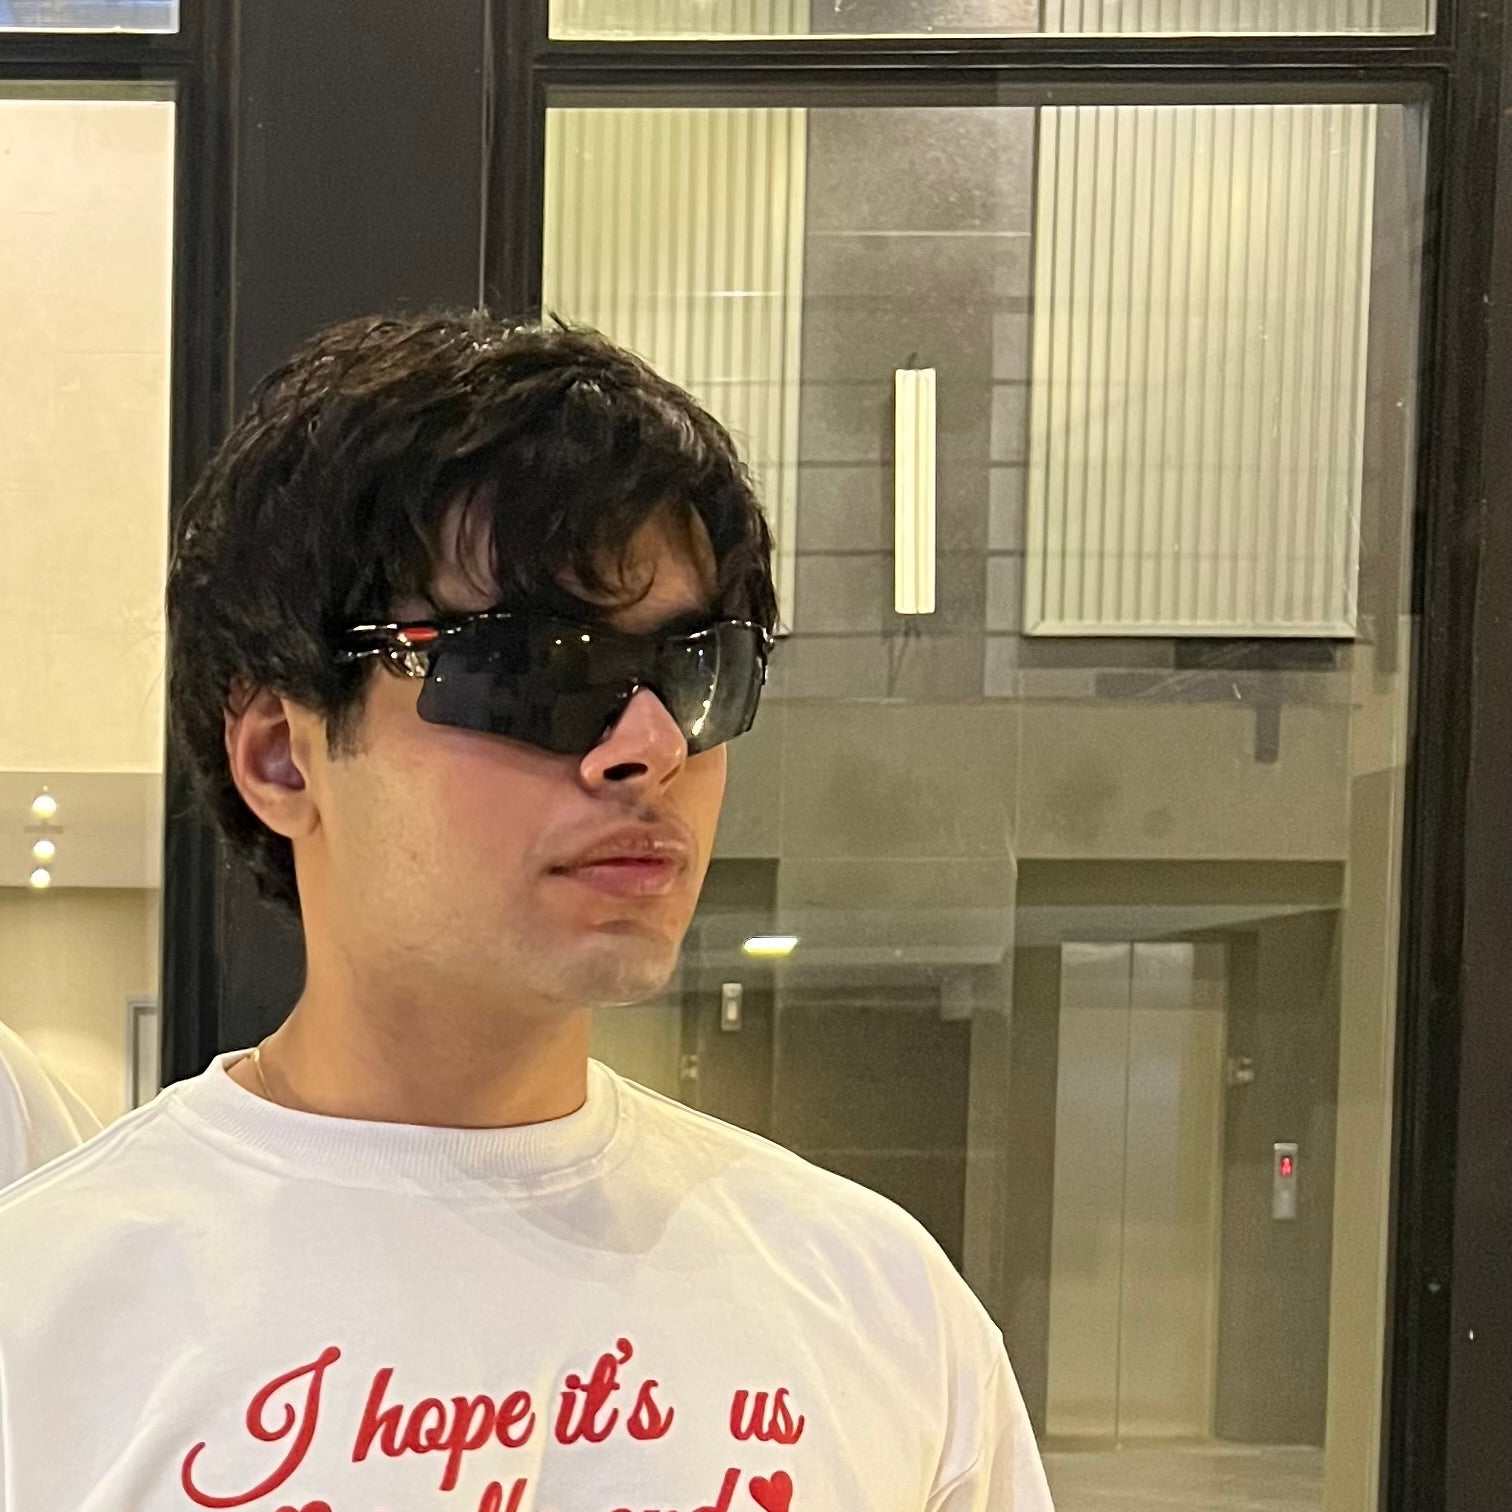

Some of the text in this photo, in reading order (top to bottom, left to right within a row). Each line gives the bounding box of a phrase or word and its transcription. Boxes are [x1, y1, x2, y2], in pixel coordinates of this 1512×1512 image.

[180, 1337, 806, 1511] I hope it's us
